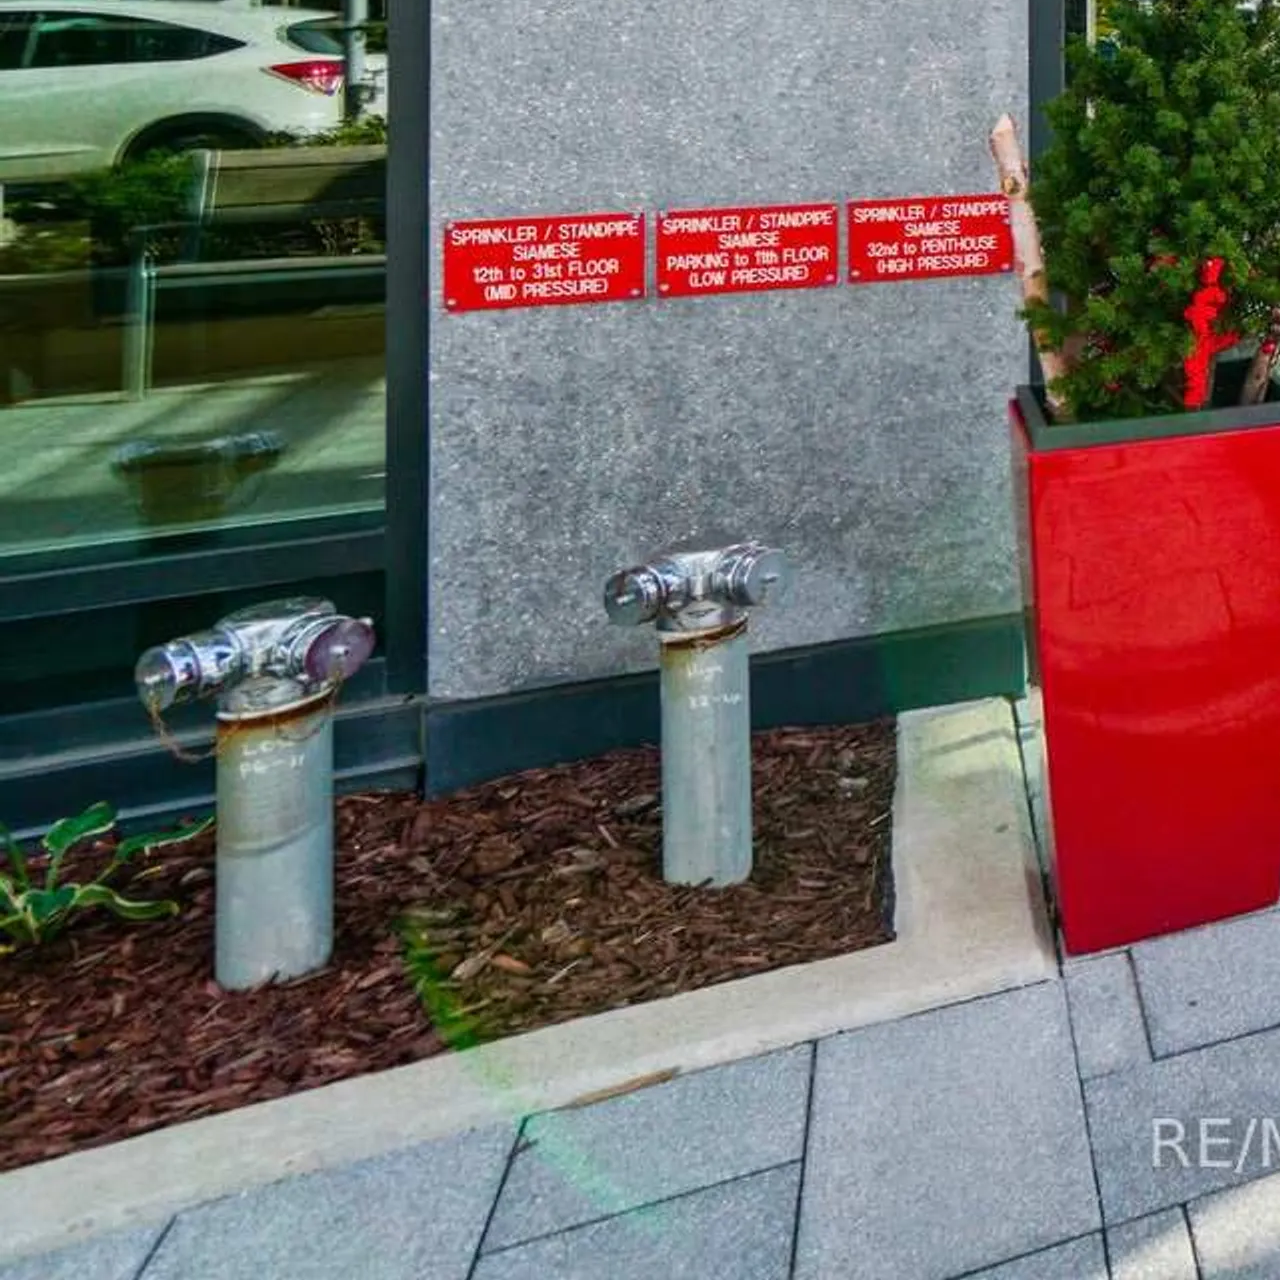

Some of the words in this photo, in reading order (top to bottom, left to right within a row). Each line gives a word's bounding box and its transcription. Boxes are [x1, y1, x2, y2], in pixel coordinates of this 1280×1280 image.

[662, 215, 741, 235] SPRINKLER
[760, 210, 833, 229] STANDPIPE
[853, 205, 925, 223] SPRINKLER
[942, 200, 1009, 218] STANDPIPE
[451, 226, 537, 246] SPRINKLER
[559, 220, 639, 240] STANDPIPE
[904, 220, 961, 237] SIAMESE
[718, 231, 781, 249] SIAMESE
[867, 242, 899, 257] 32nd
[904, 241, 916, 254] to
[921, 235, 998, 253] PENTHOUSE
[513, 242, 582, 262] SIAMESE
[667, 252, 729, 271] PARKING
[734, 251, 749, 266] to
[783, 246, 829, 263] FLOOR
[877, 257, 913, 273] (HIGH
[918, 252, 988, 270] PRESSURE)
[473, 266, 503, 283] 12th
[510, 265, 525, 281] to
[532, 262, 563, 280] 31st
[568, 258, 619, 277] FLOOR
[689, 270, 725, 288] (LOW
[732, 266, 808, 285] PRESSURE)
[484, 284, 516, 301] (MID
[523, 278, 608, 298] PRESSURE)
